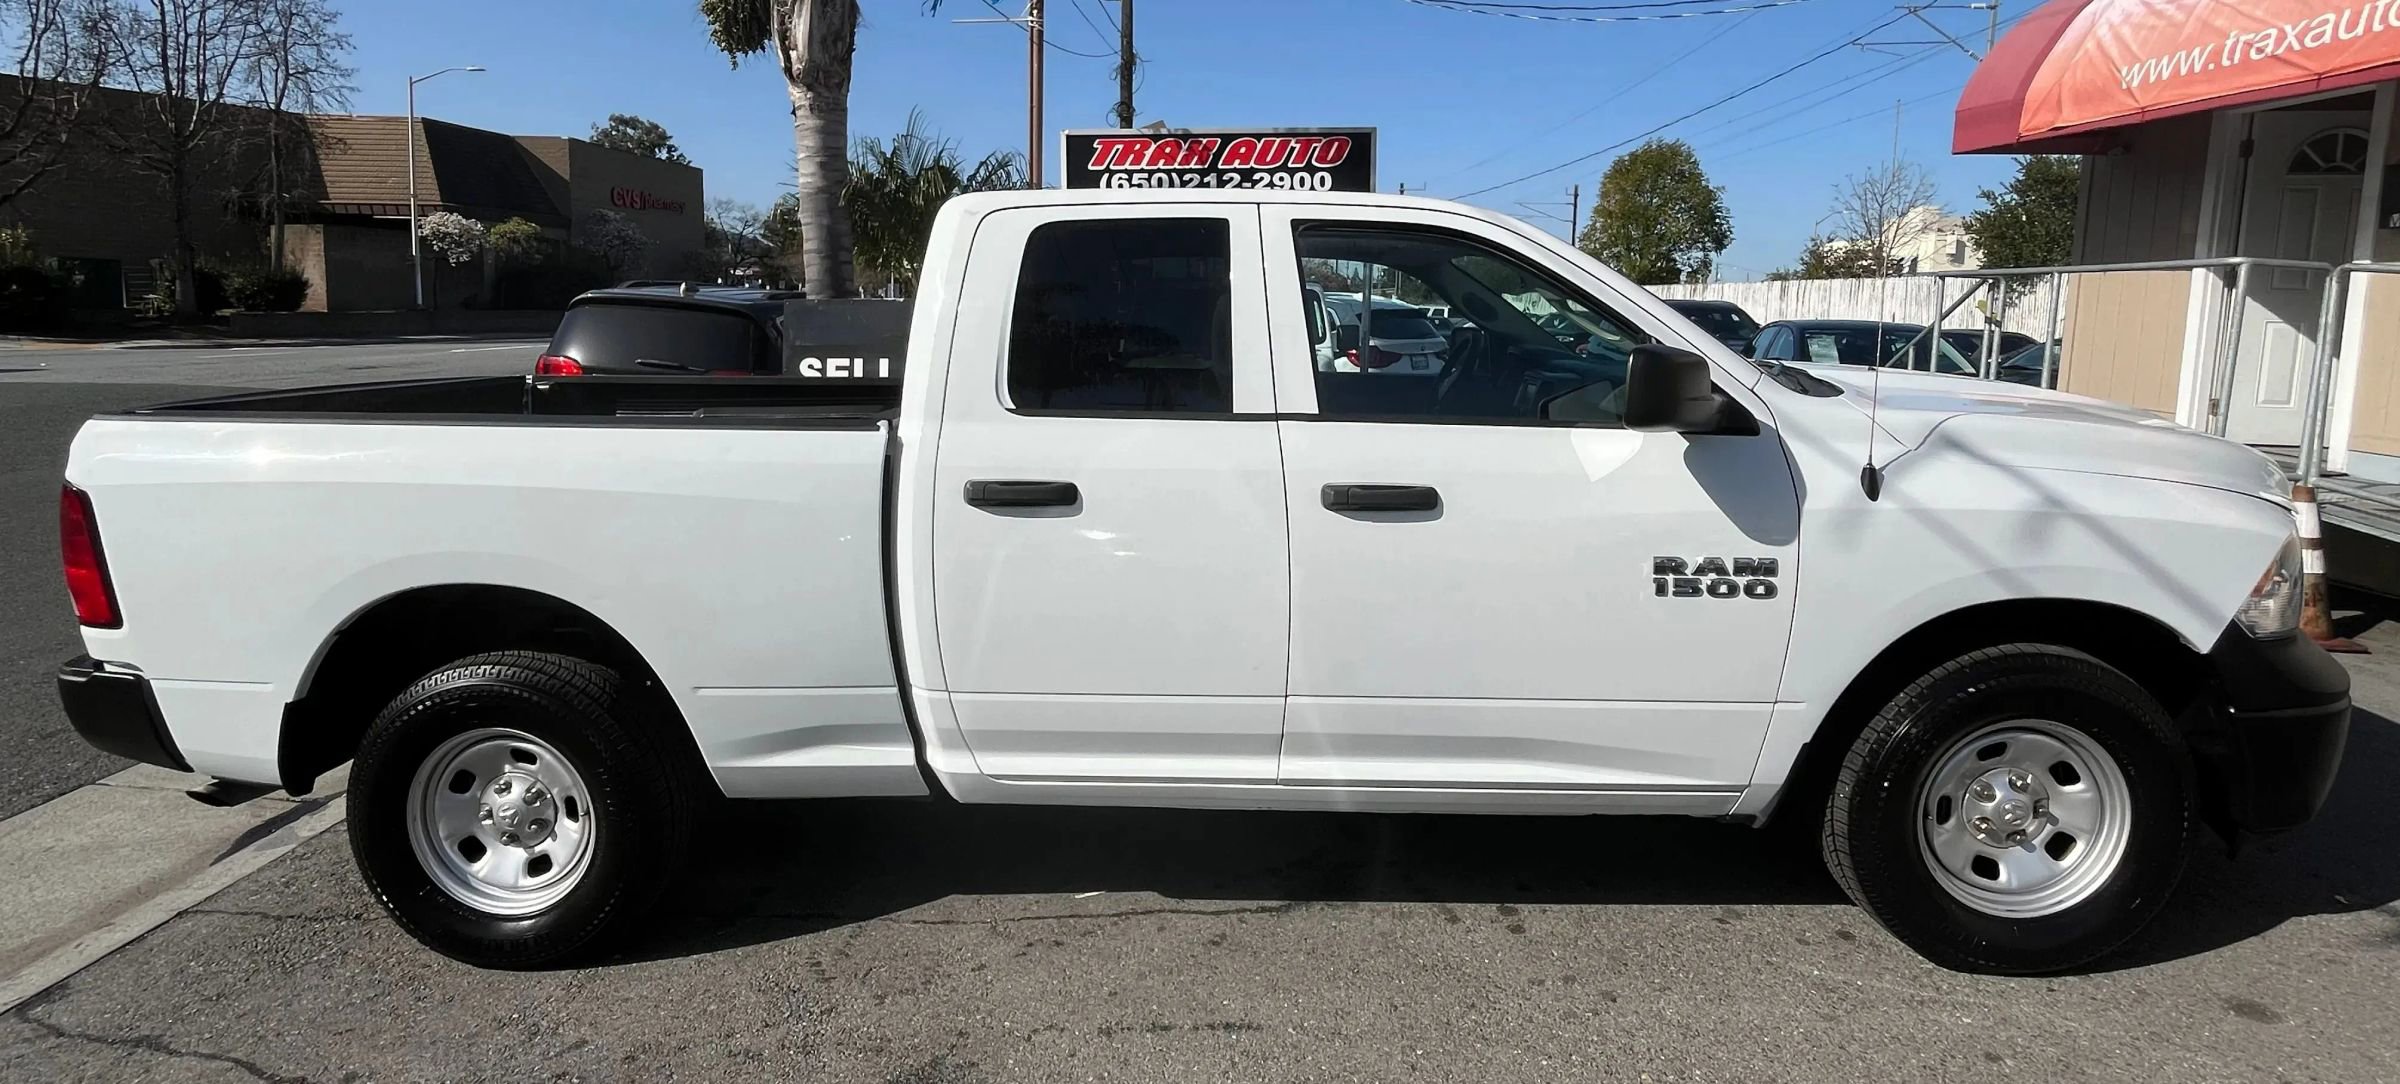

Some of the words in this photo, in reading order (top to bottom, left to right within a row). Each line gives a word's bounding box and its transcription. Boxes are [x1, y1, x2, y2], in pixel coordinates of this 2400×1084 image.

[1088, 137, 1221, 170] TRAX
[1217, 136, 1352, 170] AUTO
[1100, 171, 1333, 192] (650)212-2900
[1653, 556, 1778, 578] RAM
[1653, 577, 1778, 600] 1500
